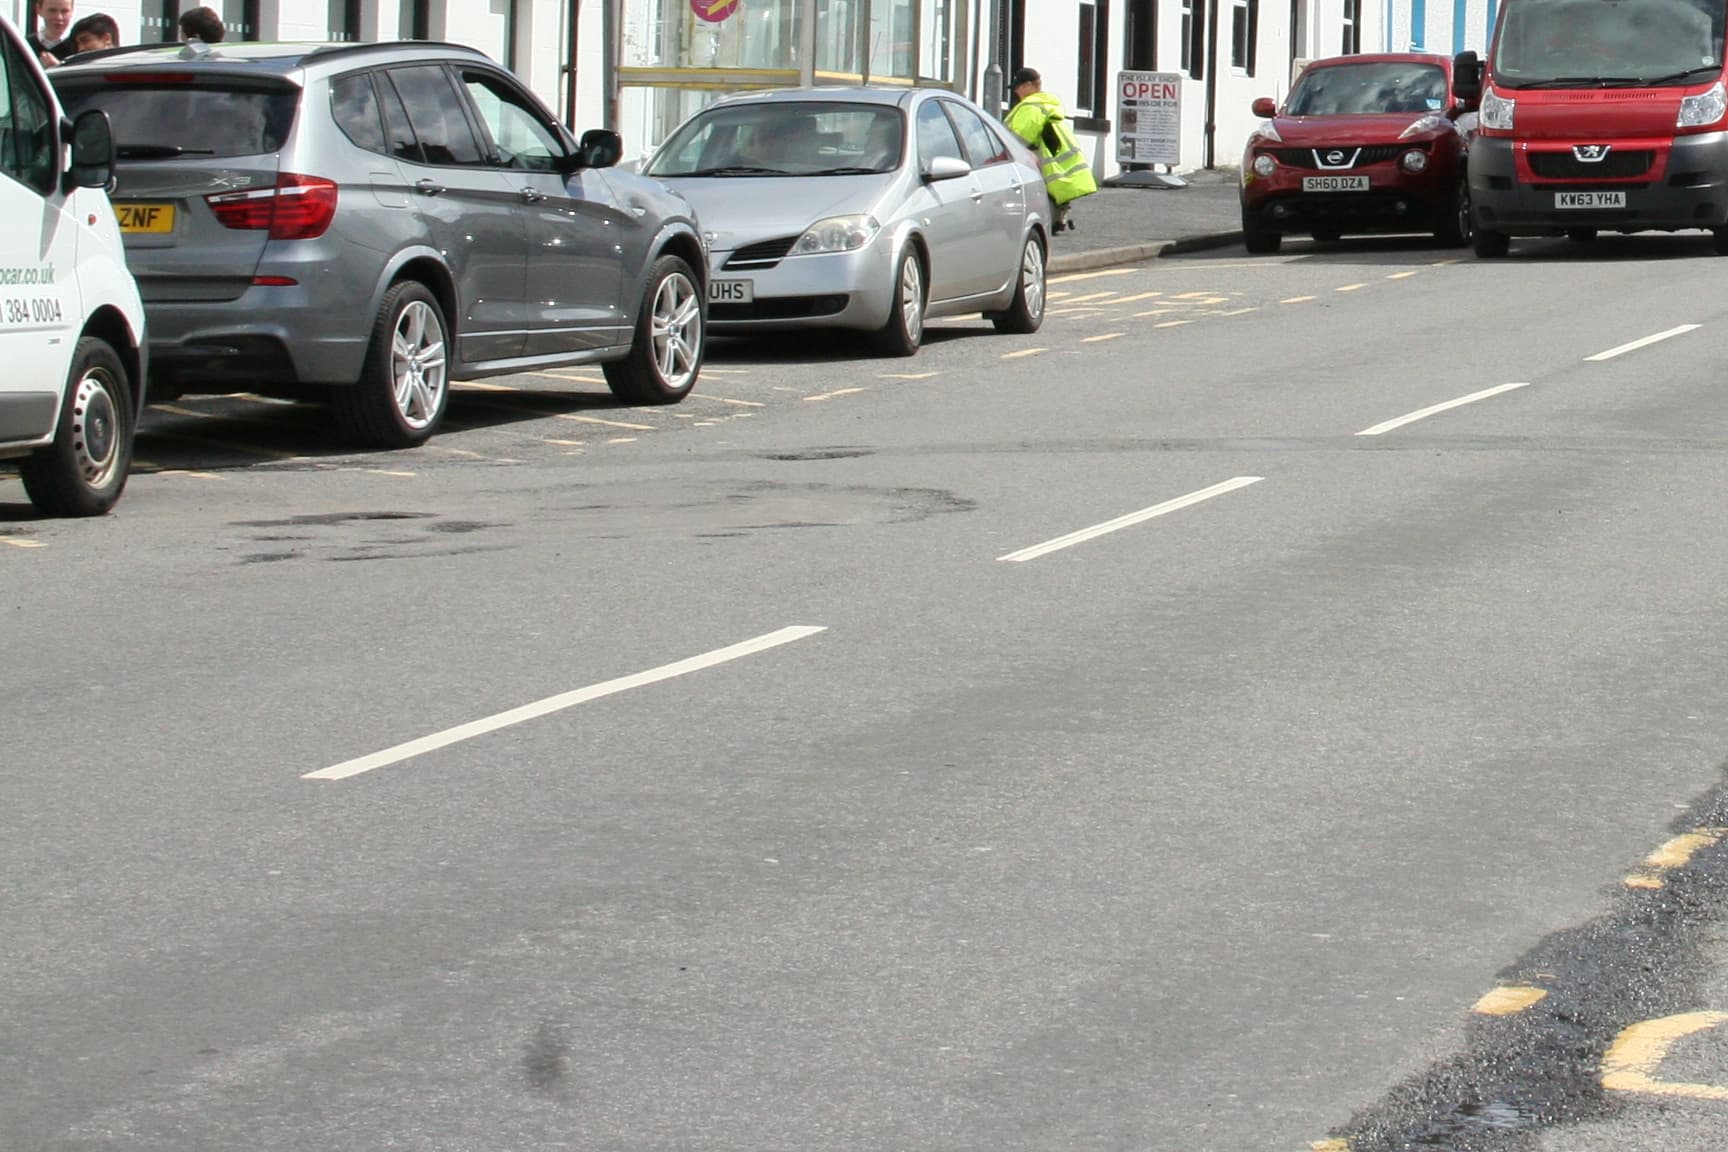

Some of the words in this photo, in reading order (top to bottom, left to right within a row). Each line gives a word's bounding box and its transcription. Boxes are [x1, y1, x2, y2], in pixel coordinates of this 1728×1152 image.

[1120, 74, 1134, 82] THE
[1122, 82, 1176, 100] OPEN
[1307, 178, 1338, 189] SH60
[1341, 177, 1364, 189] DZA
[1560, 193, 1593, 206] KW63
[1596, 193, 1621, 205] YHA
[119, 208, 161, 228] ZNF
[710, 283, 744, 299] UHS
[6, 299, 30, 323] 384
[32, 299, 62, 323] 0004
